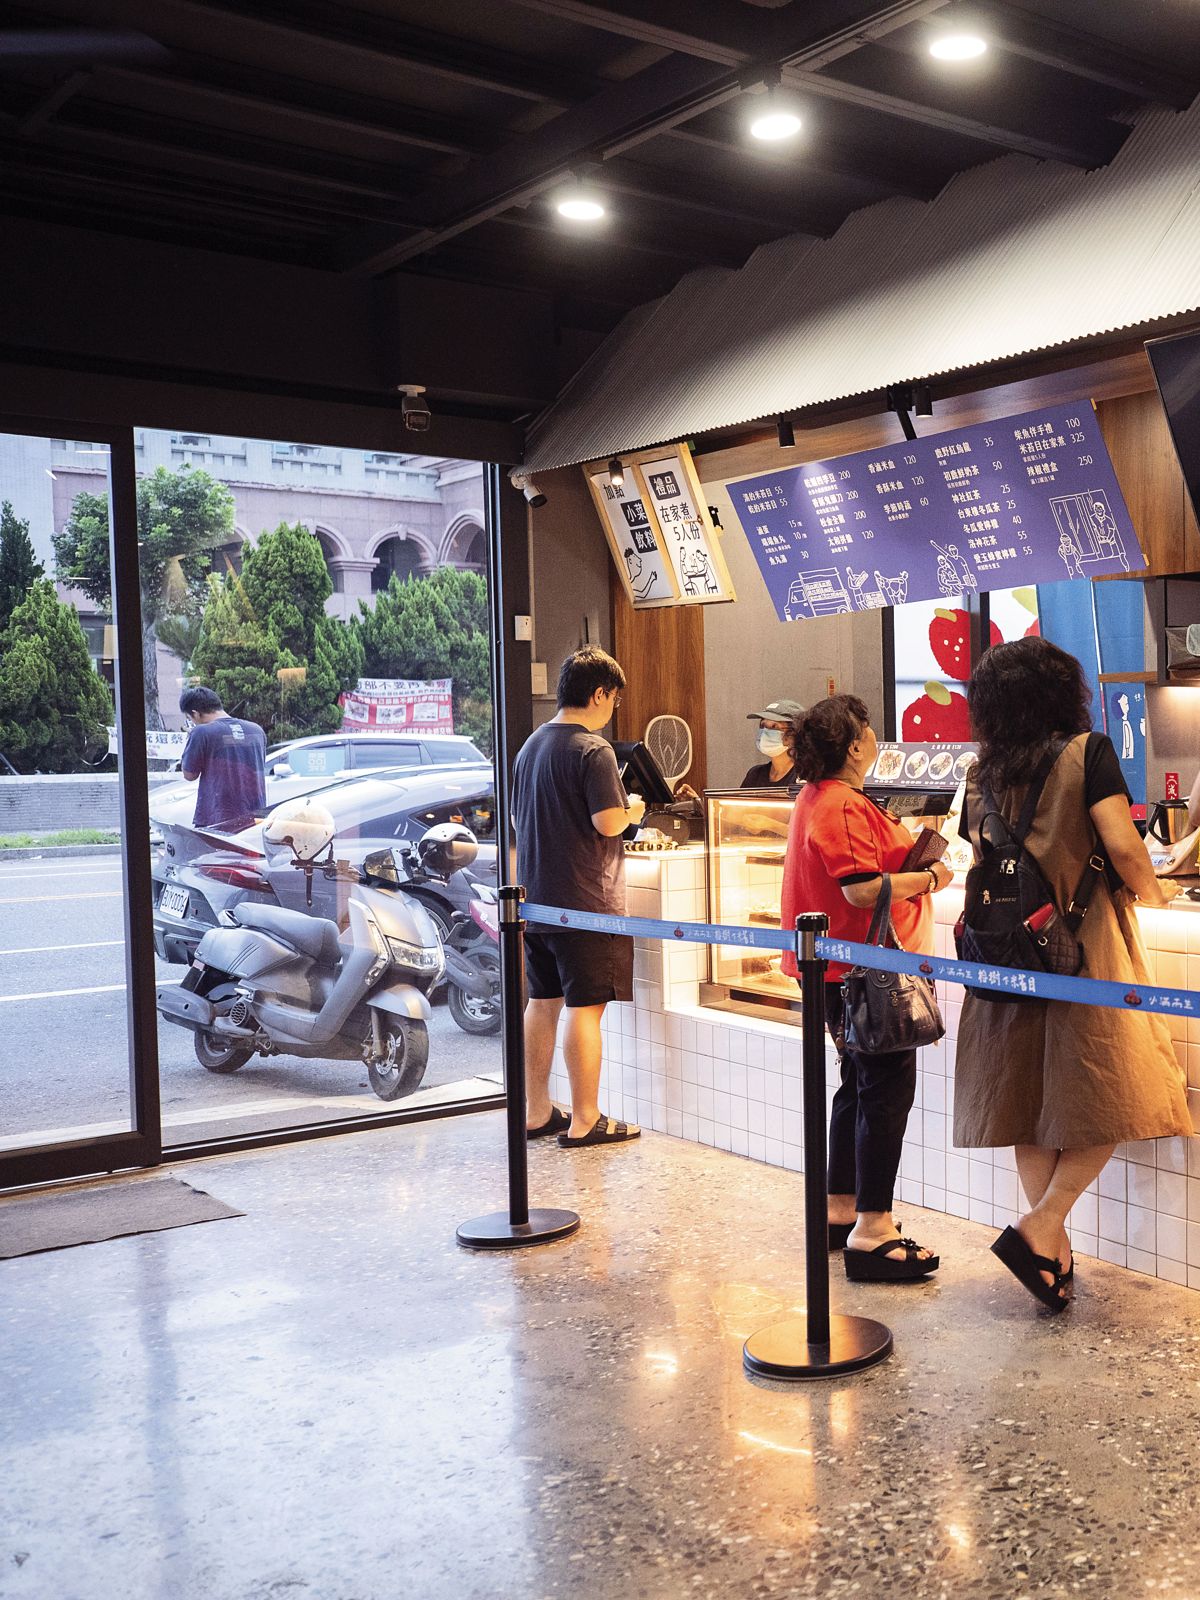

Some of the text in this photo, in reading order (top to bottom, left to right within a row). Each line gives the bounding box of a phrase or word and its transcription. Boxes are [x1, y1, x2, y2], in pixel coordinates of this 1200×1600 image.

[1014, 417, 1080, 441] 柴魚伴手禮 100
[983, 437, 994, 447] 35
[1019, 432, 1085, 454] 米苔目在家煮 325
[903, 454, 917, 465] 120
[1078, 455, 1093, 466] 250
[992, 460, 1003, 471] 50
[838, 470, 851, 480] 200
[911, 475, 924, 486] 120
[654, 476, 677, 496] 禮品
[774, 486, 783, 495] 55
[1001, 483, 1011, 494] 25
[846, 490, 859, 500] 200
[779, 498, 788, 507] 55
[920, 497, 929, 507] 60
[1006, 500, 1016, 509] 25
[660, 502, 693, 522] 在家煮
[854, 510, 867, 520] 200
[1012, 515, 1022, 525] 40
[673, 522, 700, 541] 5人份
[862, 530, 874, 540] 120
[1017, 530, 1028, 541] 55
[801, 550, 809, 559] 30
[1022, 546, 1033, 556] 55
